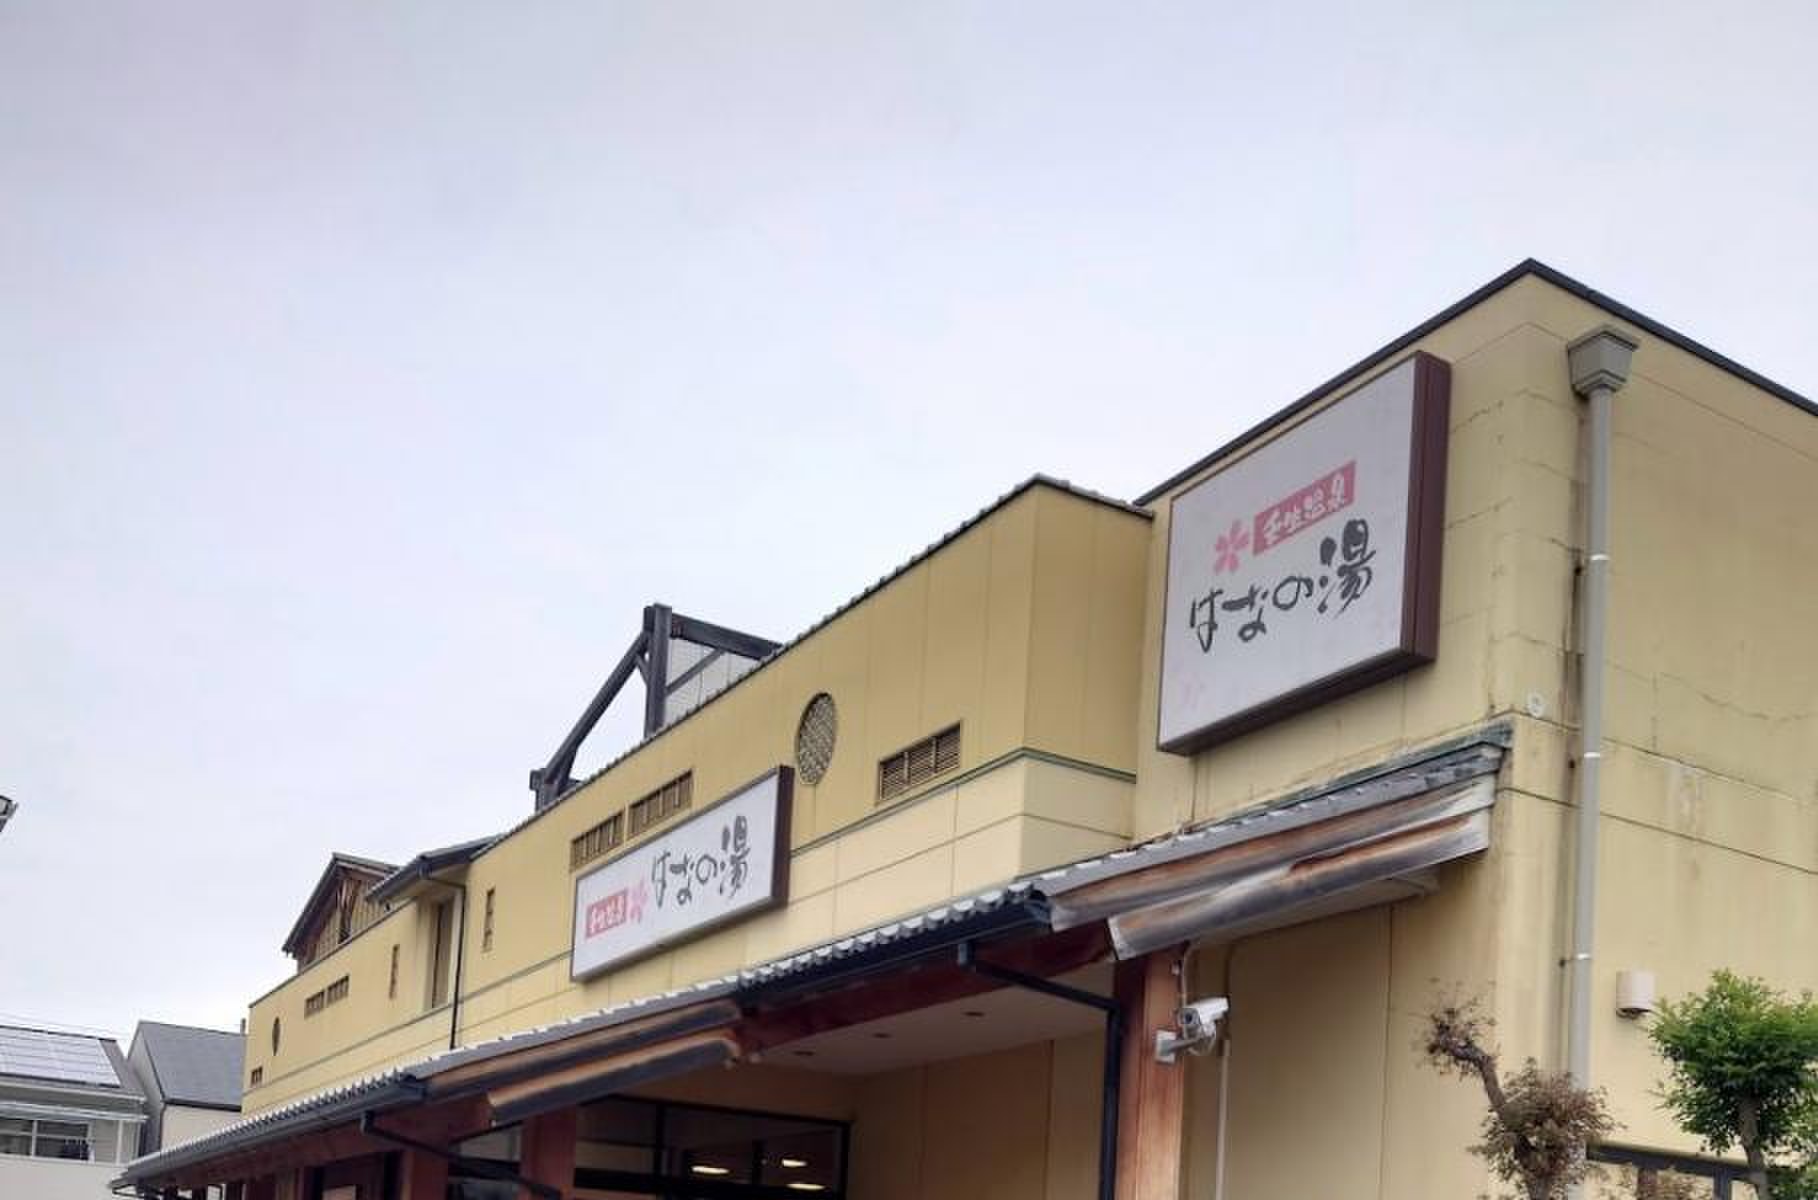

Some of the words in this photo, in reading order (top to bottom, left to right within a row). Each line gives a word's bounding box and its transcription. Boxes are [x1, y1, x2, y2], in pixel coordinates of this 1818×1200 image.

[1190, 518, 1376, 653] はなの湯
[651, 815, 751, 909] はなの湯
